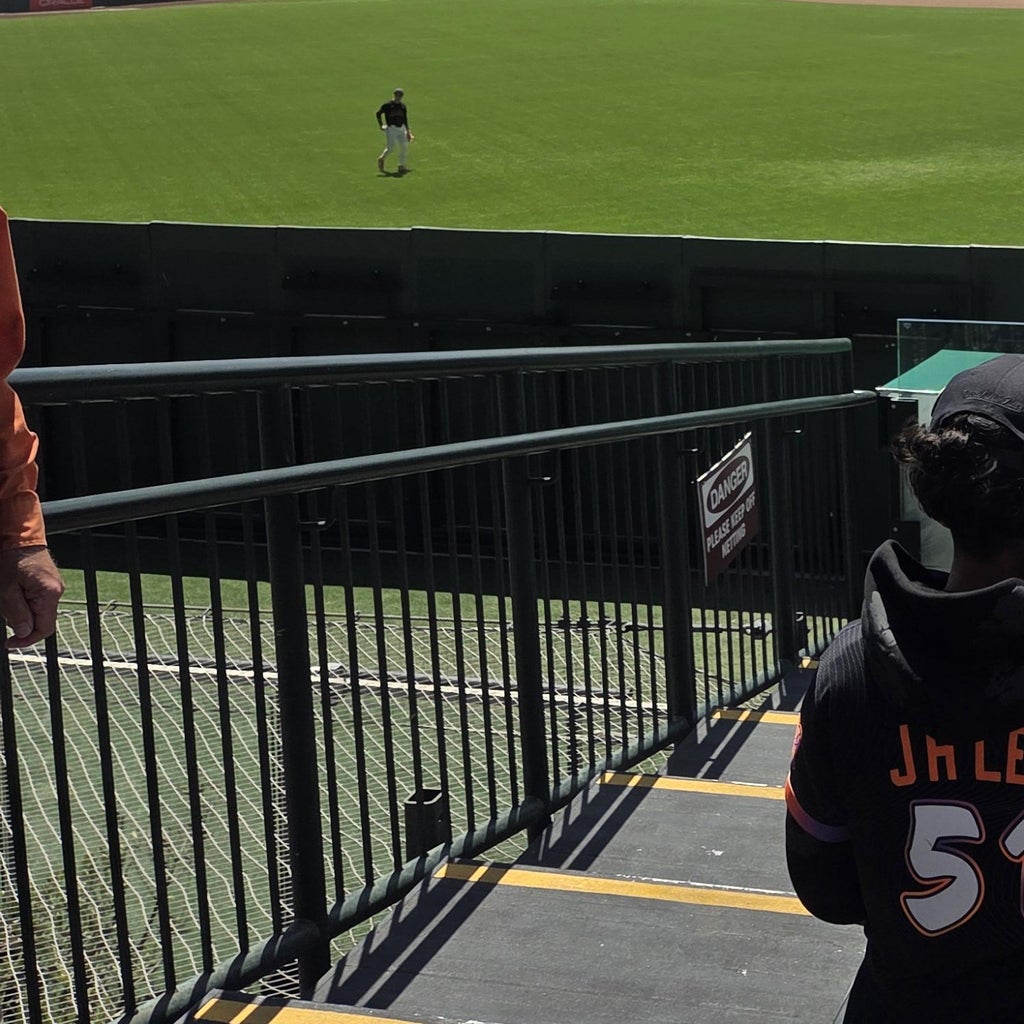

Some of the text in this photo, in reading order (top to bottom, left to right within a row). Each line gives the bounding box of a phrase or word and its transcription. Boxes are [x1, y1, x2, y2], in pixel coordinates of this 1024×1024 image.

[710, 460, 748, 510] DANGER
[706, 490, 756, 553] PLEASE KEEP OFF
[721, 522, 746, 559] NETTING
